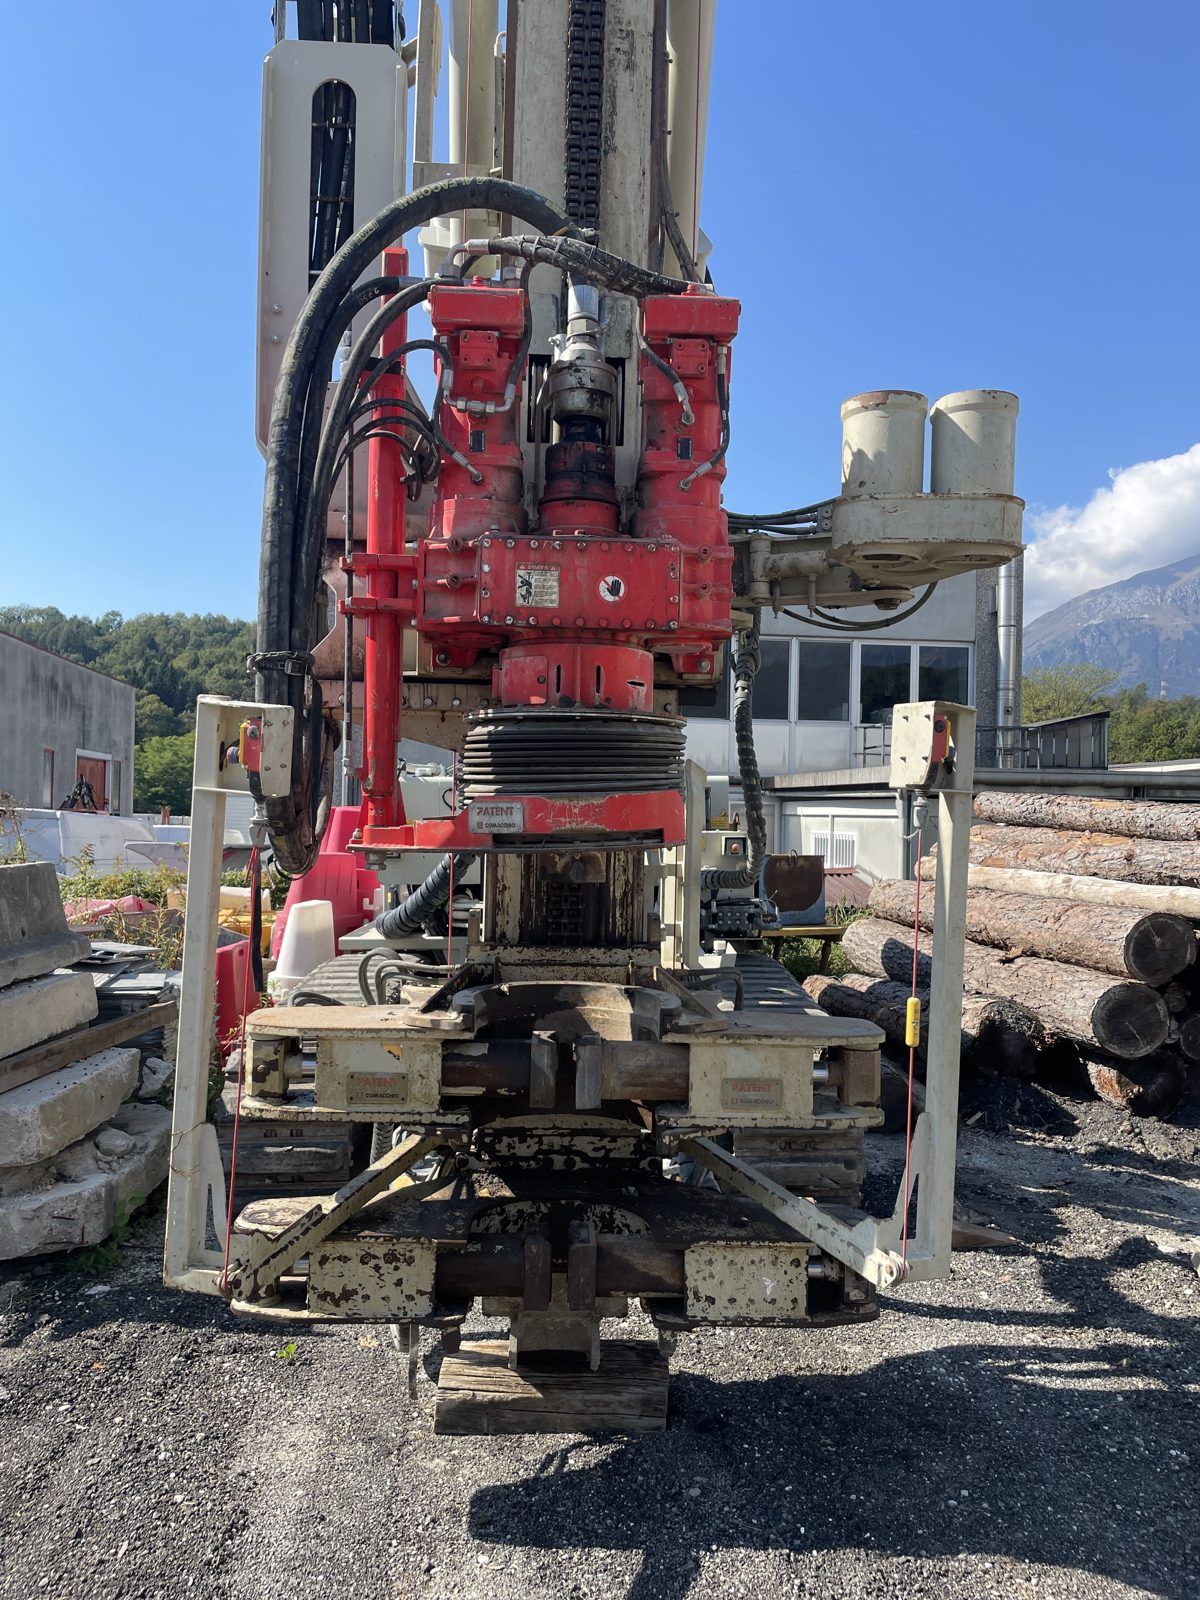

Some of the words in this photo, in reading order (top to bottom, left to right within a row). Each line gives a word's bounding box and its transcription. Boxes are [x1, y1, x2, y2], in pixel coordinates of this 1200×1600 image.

[396, 176, 474, 210] ALFAGOMMA
[476, 806, 514, 816] PATENT
[356, 1077, 401, 1087] PATENT
[731, 1082, 774, 1093] PATENT
